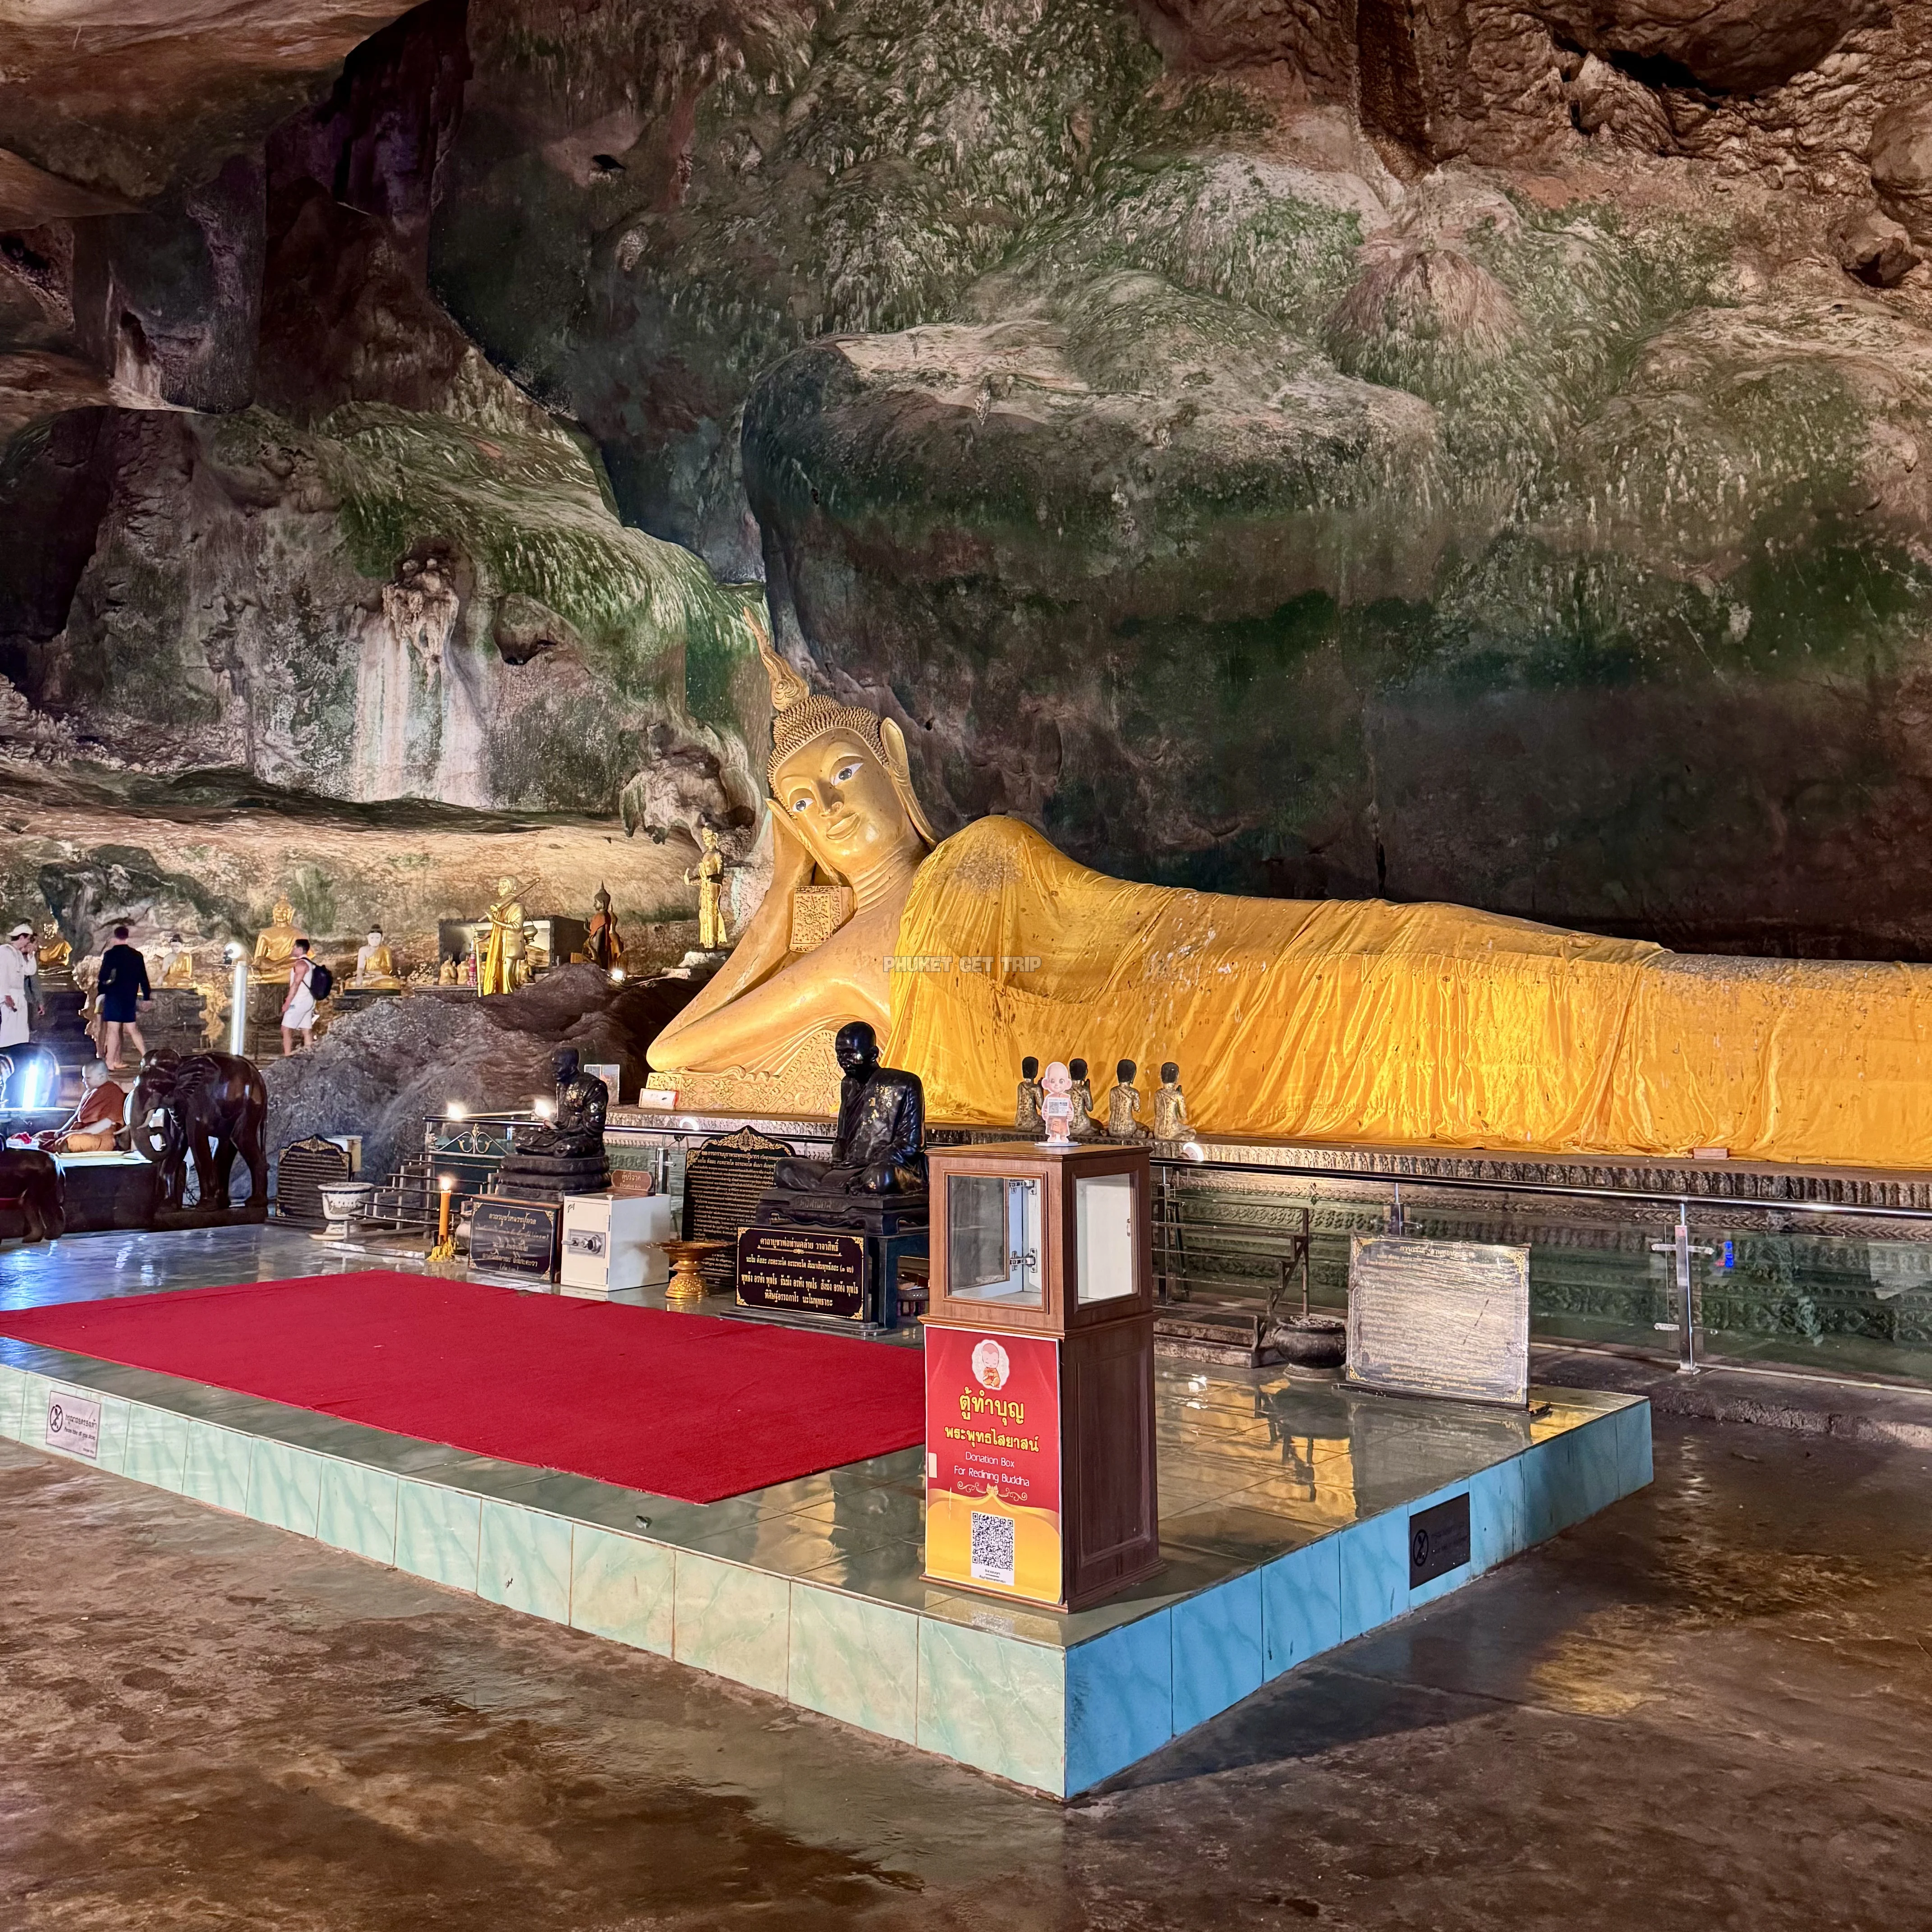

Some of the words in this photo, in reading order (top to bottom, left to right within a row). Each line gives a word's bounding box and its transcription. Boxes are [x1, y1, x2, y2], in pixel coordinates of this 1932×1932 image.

[760, 1237, 814, 1249] คาถาบูชาพ่อท่านคล้าย
[815, 1239, 839, 1251] วาจาสิทธิ์
[959, 1386, 1025, 1426] ตู้ทำบุญ
[944, 1426, 1040, 1452] พระพุทธไสยาสน์
[965, 1451, 998, 1465] Donation
[1001, 1457, 1015, 1468] Box
[954, 1465, 966, 1475] For
[968, 1467, 999, 1484] Reclining
[1002, 1473, 1030, 1486] Buddha
